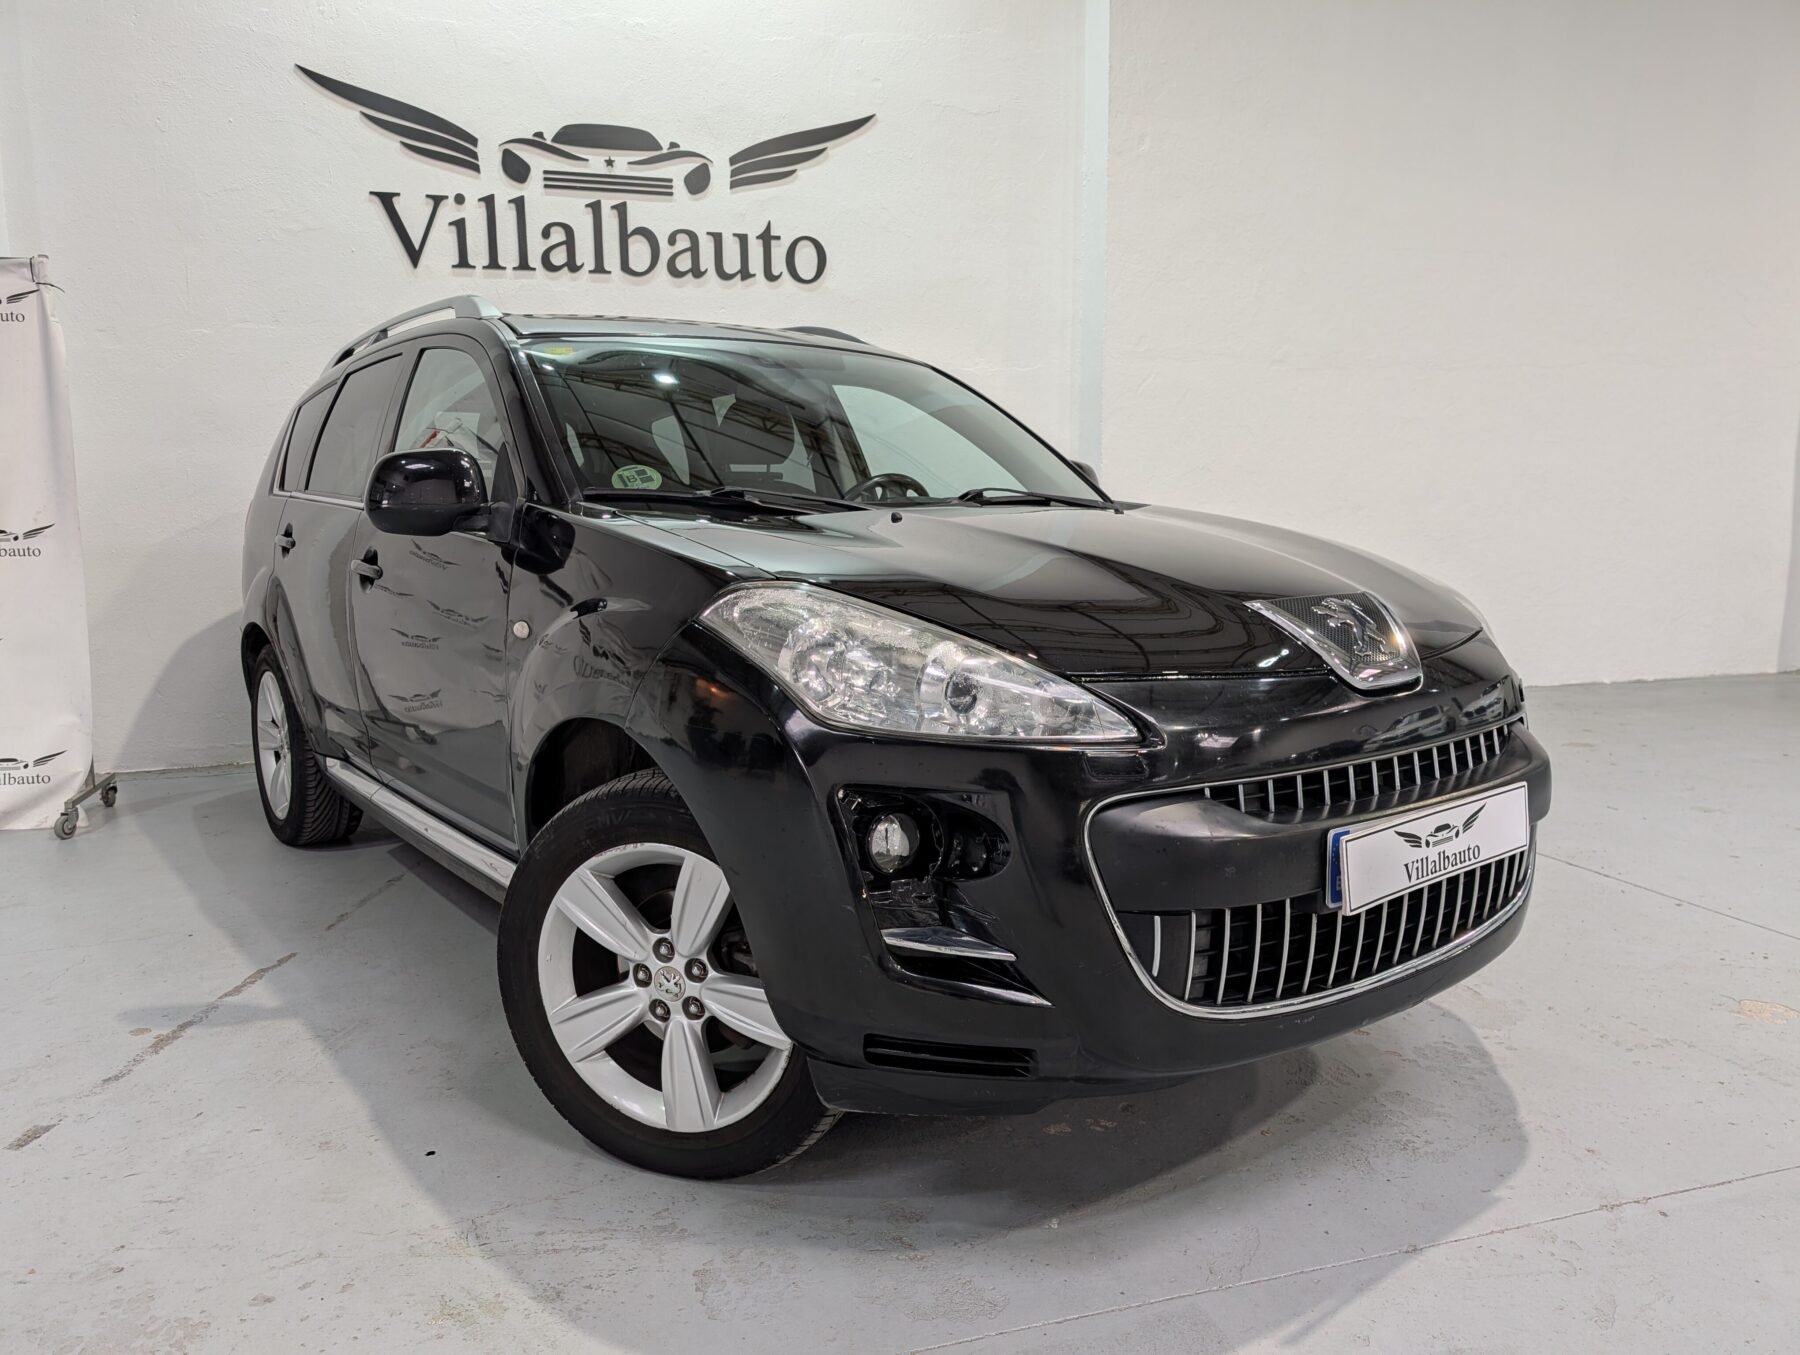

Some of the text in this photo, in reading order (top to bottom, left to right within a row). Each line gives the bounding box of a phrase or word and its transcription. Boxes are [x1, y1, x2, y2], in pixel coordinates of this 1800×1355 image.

[369, 190, 828, 285] Villalbauto
[0, 772, 51, 785] lbauto
[1403, 844, 1480, 883] Villalbauto
